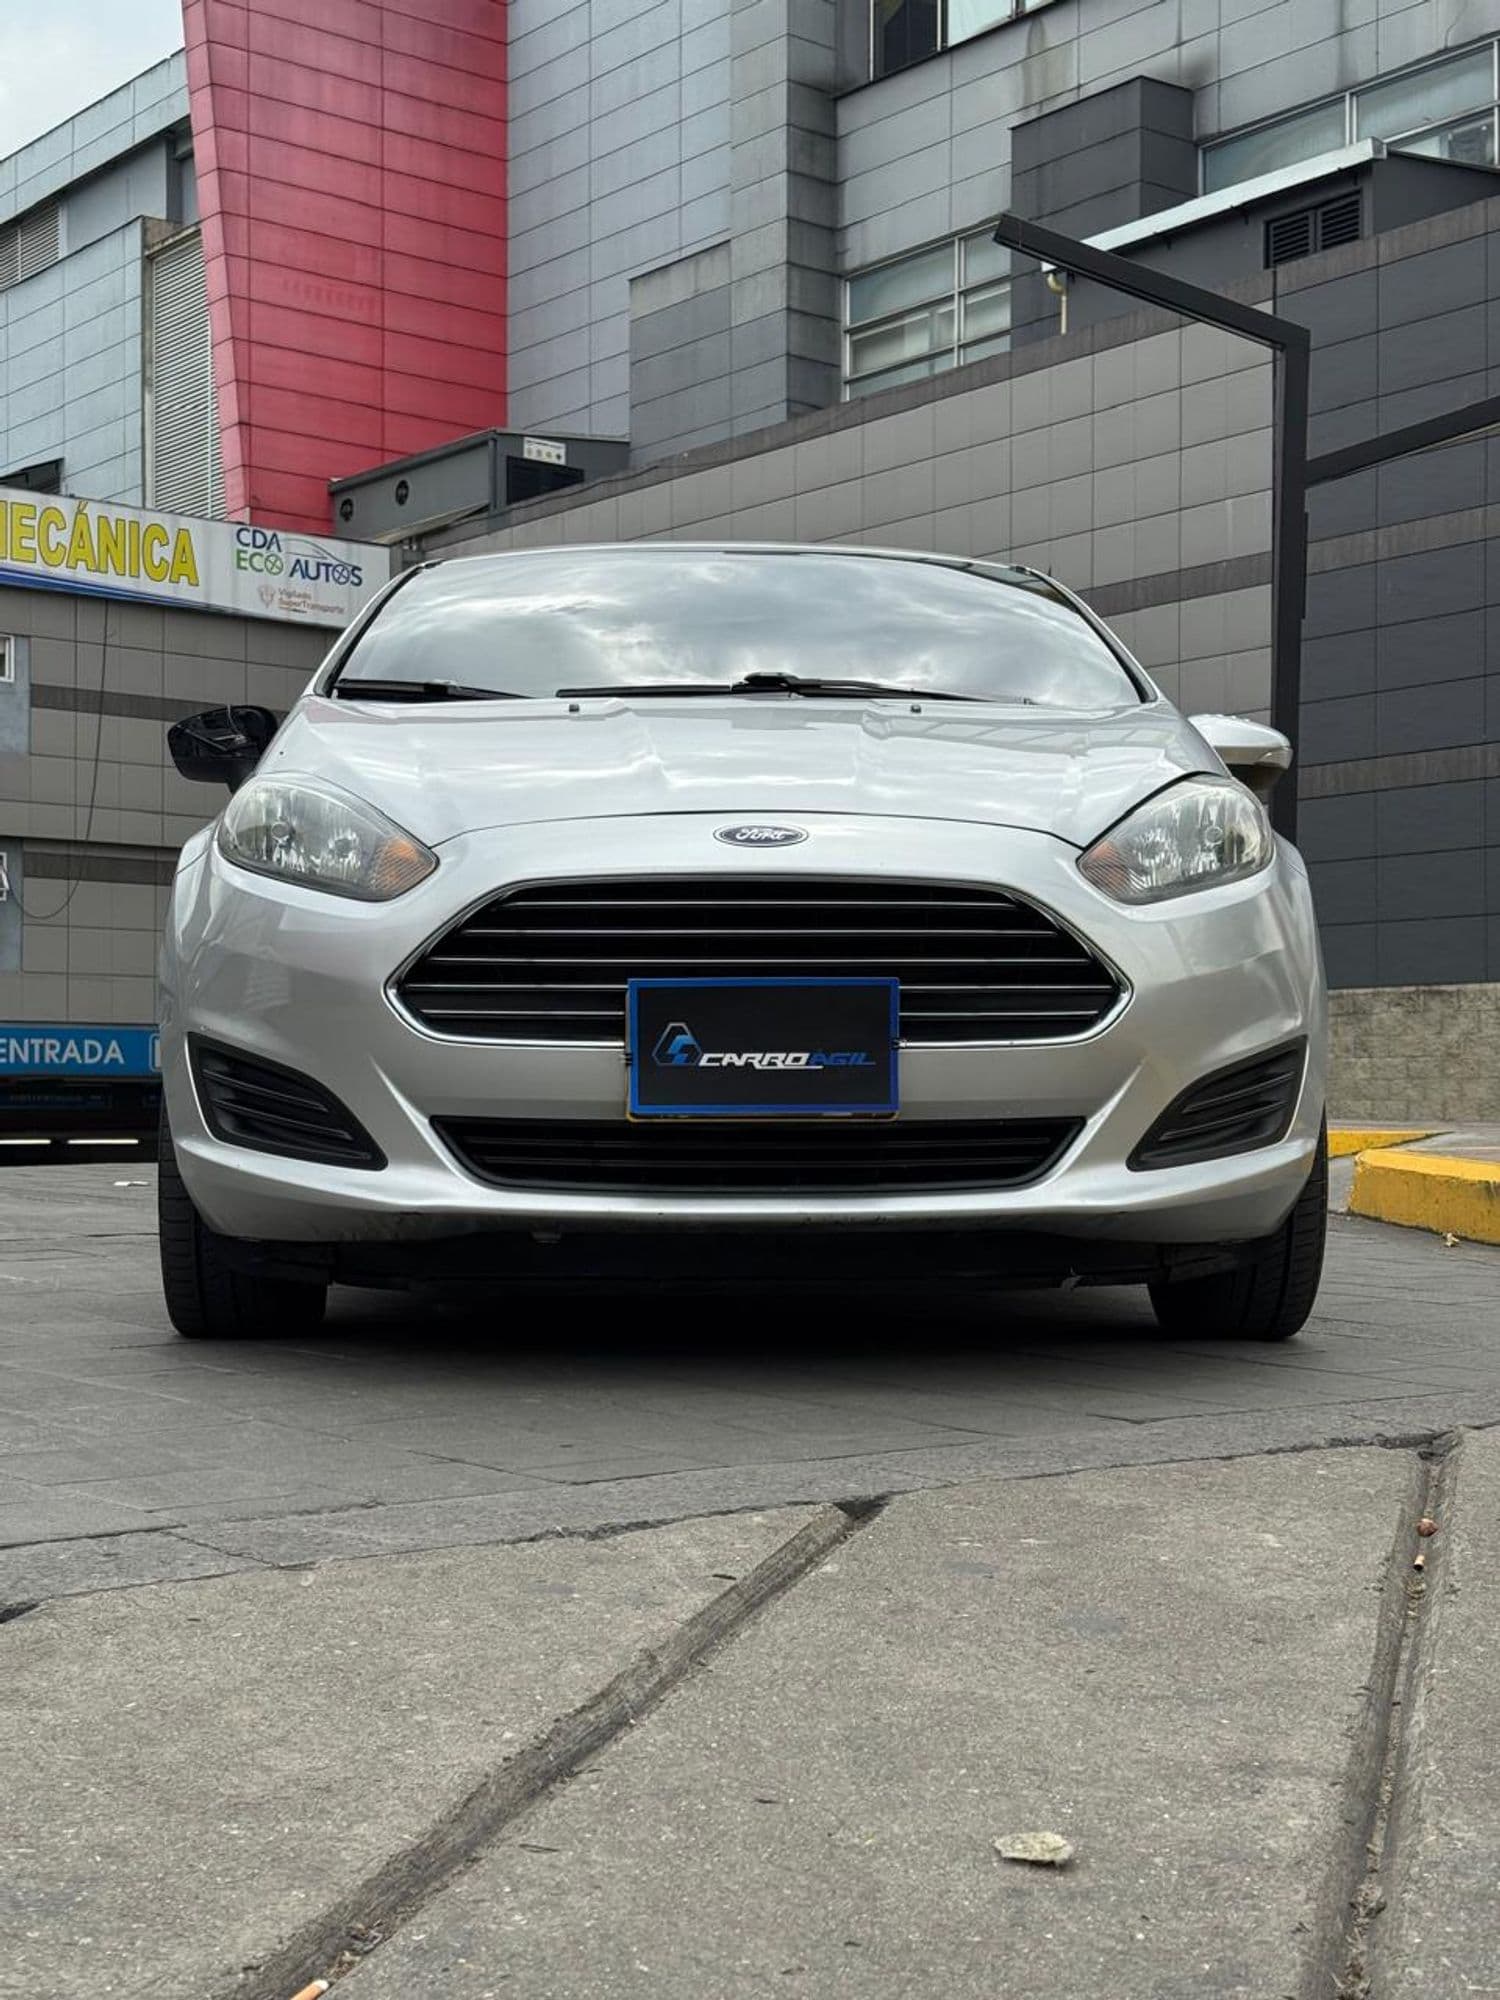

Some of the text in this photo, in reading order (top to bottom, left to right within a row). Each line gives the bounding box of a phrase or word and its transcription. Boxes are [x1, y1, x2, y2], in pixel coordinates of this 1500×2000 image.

[0, 500, 200, 587] ECÁNICA
[236, 528, 282, 553] CDA
[236, 550, 363, 587] ECO AUTOS
[0, 1038, 125, 1065] ENTRADA
